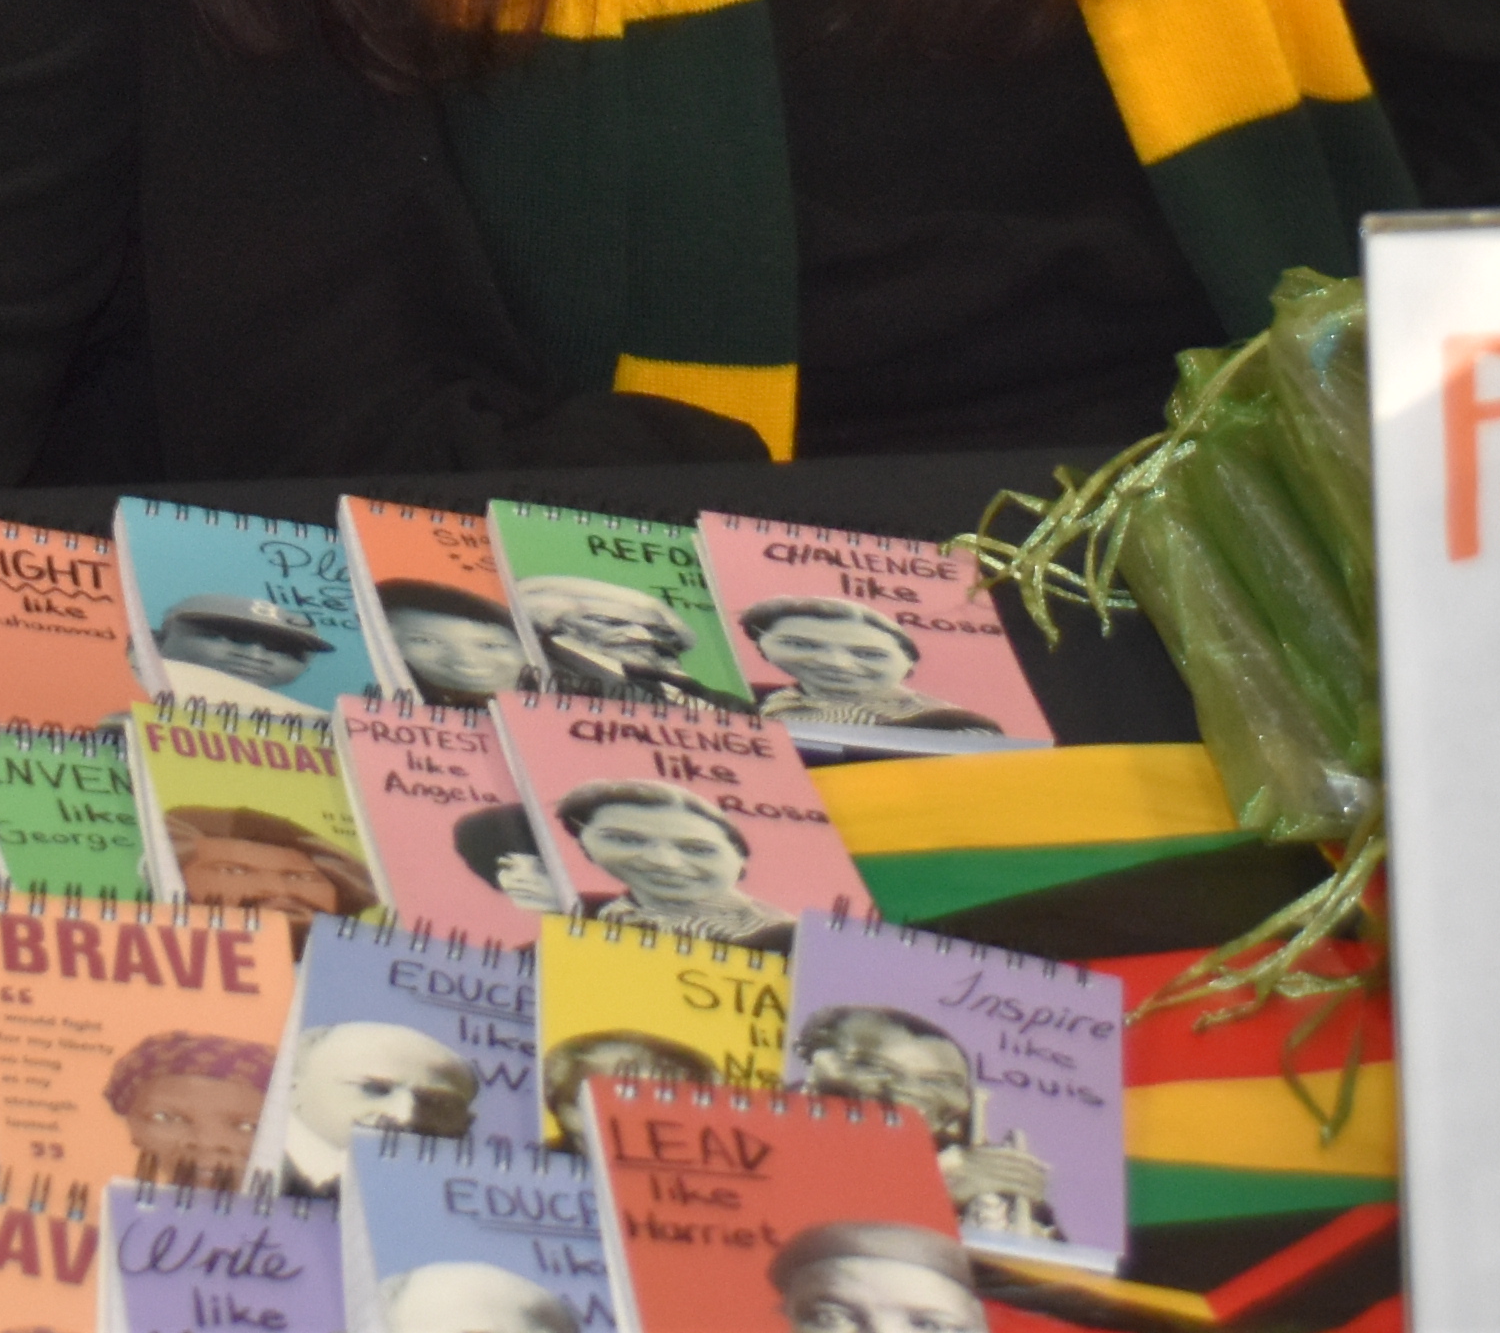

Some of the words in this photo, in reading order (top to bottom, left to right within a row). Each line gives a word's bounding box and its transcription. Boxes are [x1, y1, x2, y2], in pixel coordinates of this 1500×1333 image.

[587, 533, 701, 567] REFO
[763, 542, 960, 583] CHALLENGE
[22, 595, 88, 621] like
[839, 573, 921, 606] like
[145, 721, 338, 777] FOUNDAT
[344, 716, 491, 756] PROTEST
[568, 719, 776, 761] CHALLENGE
[406, 750, 471, 779] like
[652, 751, 742, 786] like
[383, 770, 503, 805] Angela
[56, 796, 138, 826] like
[715, 793, 832, 826] Rosa
[0, 913, 262, 995] BRAVE
[936, 969, 1118, 1041] Inspire
[996, 1030, 1077, 1072] like
[973, 1053, 1107, 1110] Louis
[609, 1115, 773, 1172] LEAD
[649, 1175, 743, 1213] like
[116, 1217, 304, 1281] Write
[191, 1285, 289, 1332] like
